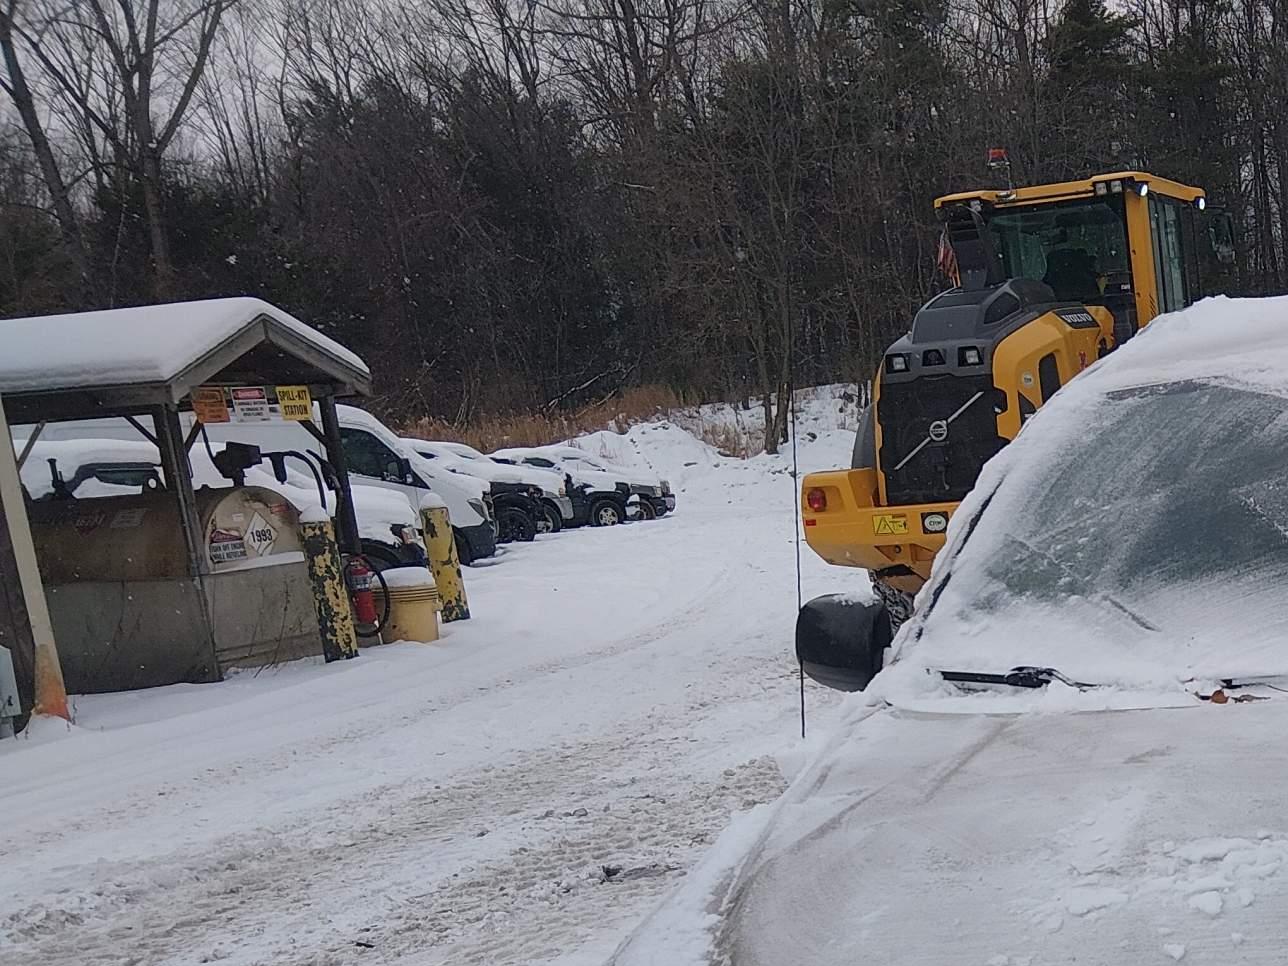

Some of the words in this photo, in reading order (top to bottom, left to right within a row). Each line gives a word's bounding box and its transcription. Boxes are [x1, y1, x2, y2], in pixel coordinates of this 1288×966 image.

[1061, 312, 1093, 323] VOLVO
[278, 389, 308, 401] SPILL-KIT
[283, 404, 309, 416] STATION
[250, 528, 273, 544] 1993
